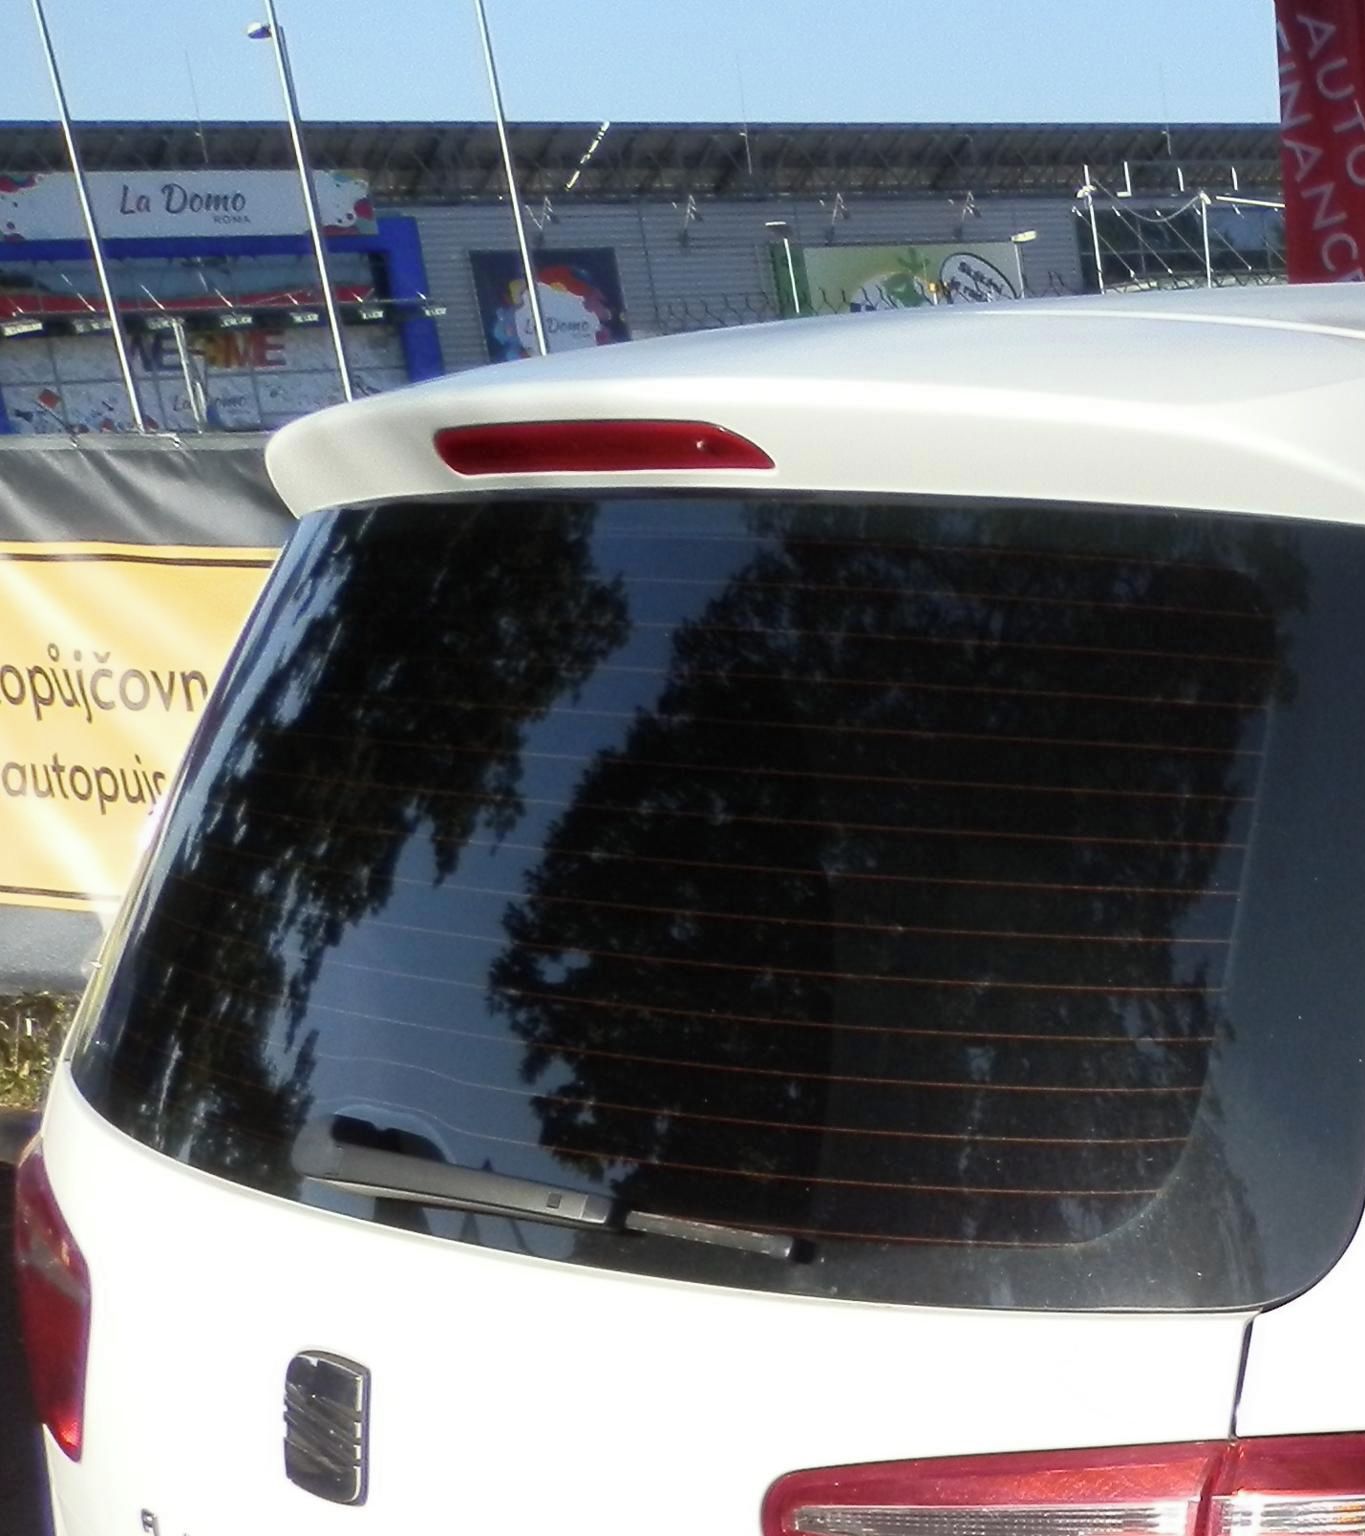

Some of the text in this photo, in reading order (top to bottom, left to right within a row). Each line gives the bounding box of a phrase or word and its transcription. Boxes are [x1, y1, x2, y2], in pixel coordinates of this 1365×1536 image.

[120, 183, 247, 215] La Domo
[1277, 20, 1365, 282] INANC
